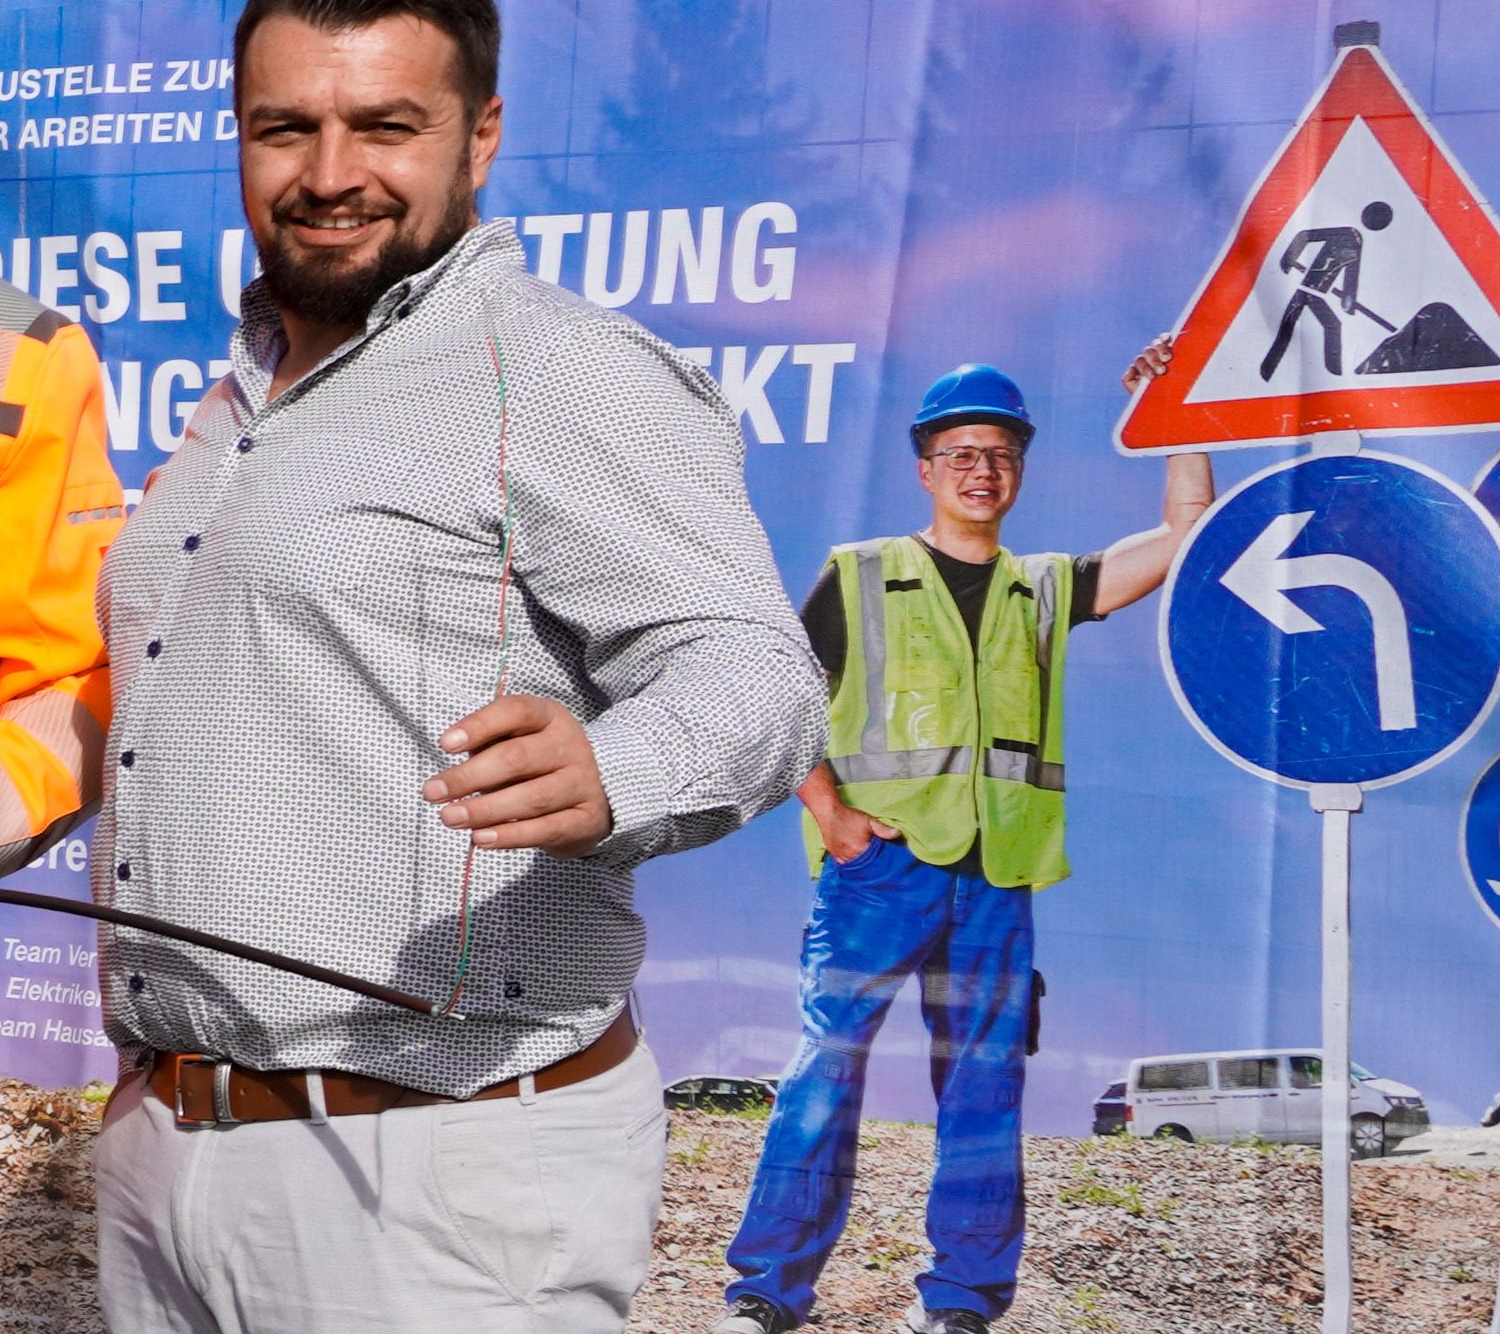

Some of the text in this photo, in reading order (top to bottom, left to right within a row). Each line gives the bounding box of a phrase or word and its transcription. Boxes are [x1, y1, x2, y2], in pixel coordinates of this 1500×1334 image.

[18, 111, 202, 150] ARBEITEN
[3, 937, 62, 965] Team
[68, 943, 98, 968] Ver
